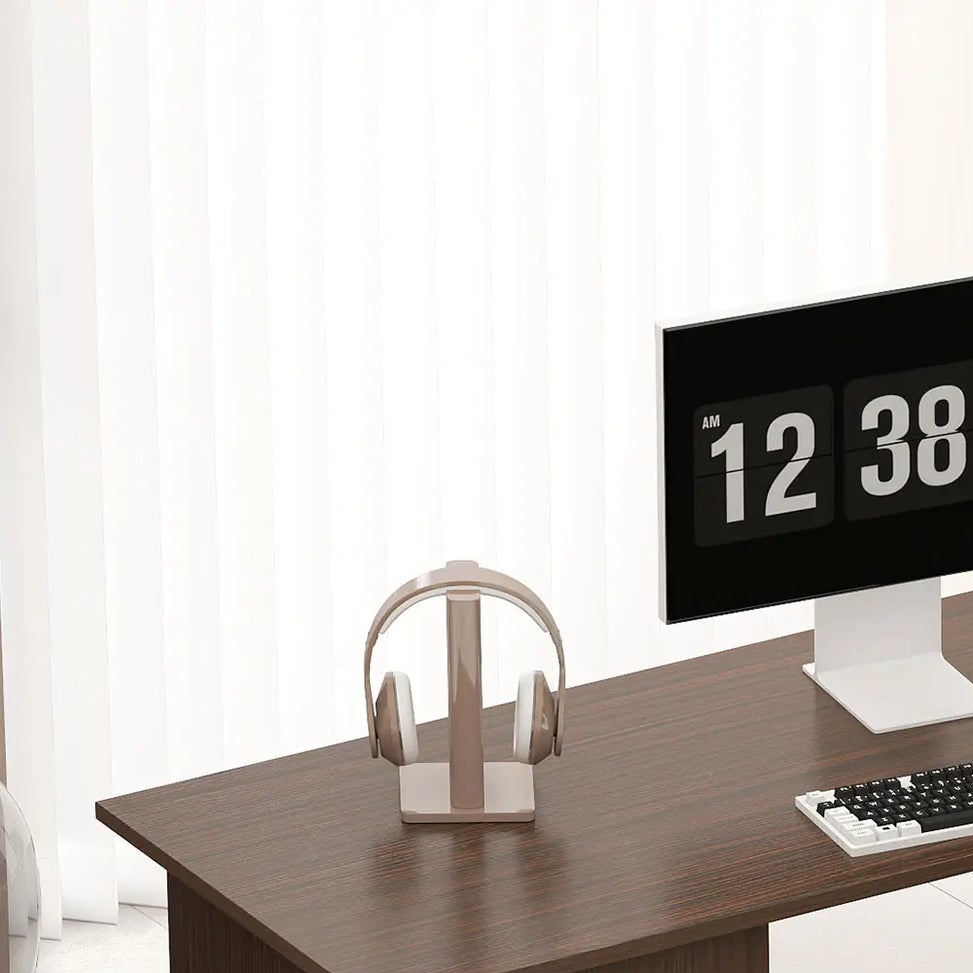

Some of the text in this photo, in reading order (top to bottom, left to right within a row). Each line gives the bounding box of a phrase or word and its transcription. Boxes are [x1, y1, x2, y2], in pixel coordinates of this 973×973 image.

[702, 415, 721, 430] AM
[711, 411, 818, 524] 12
[860, 384, 968, 497] 38
